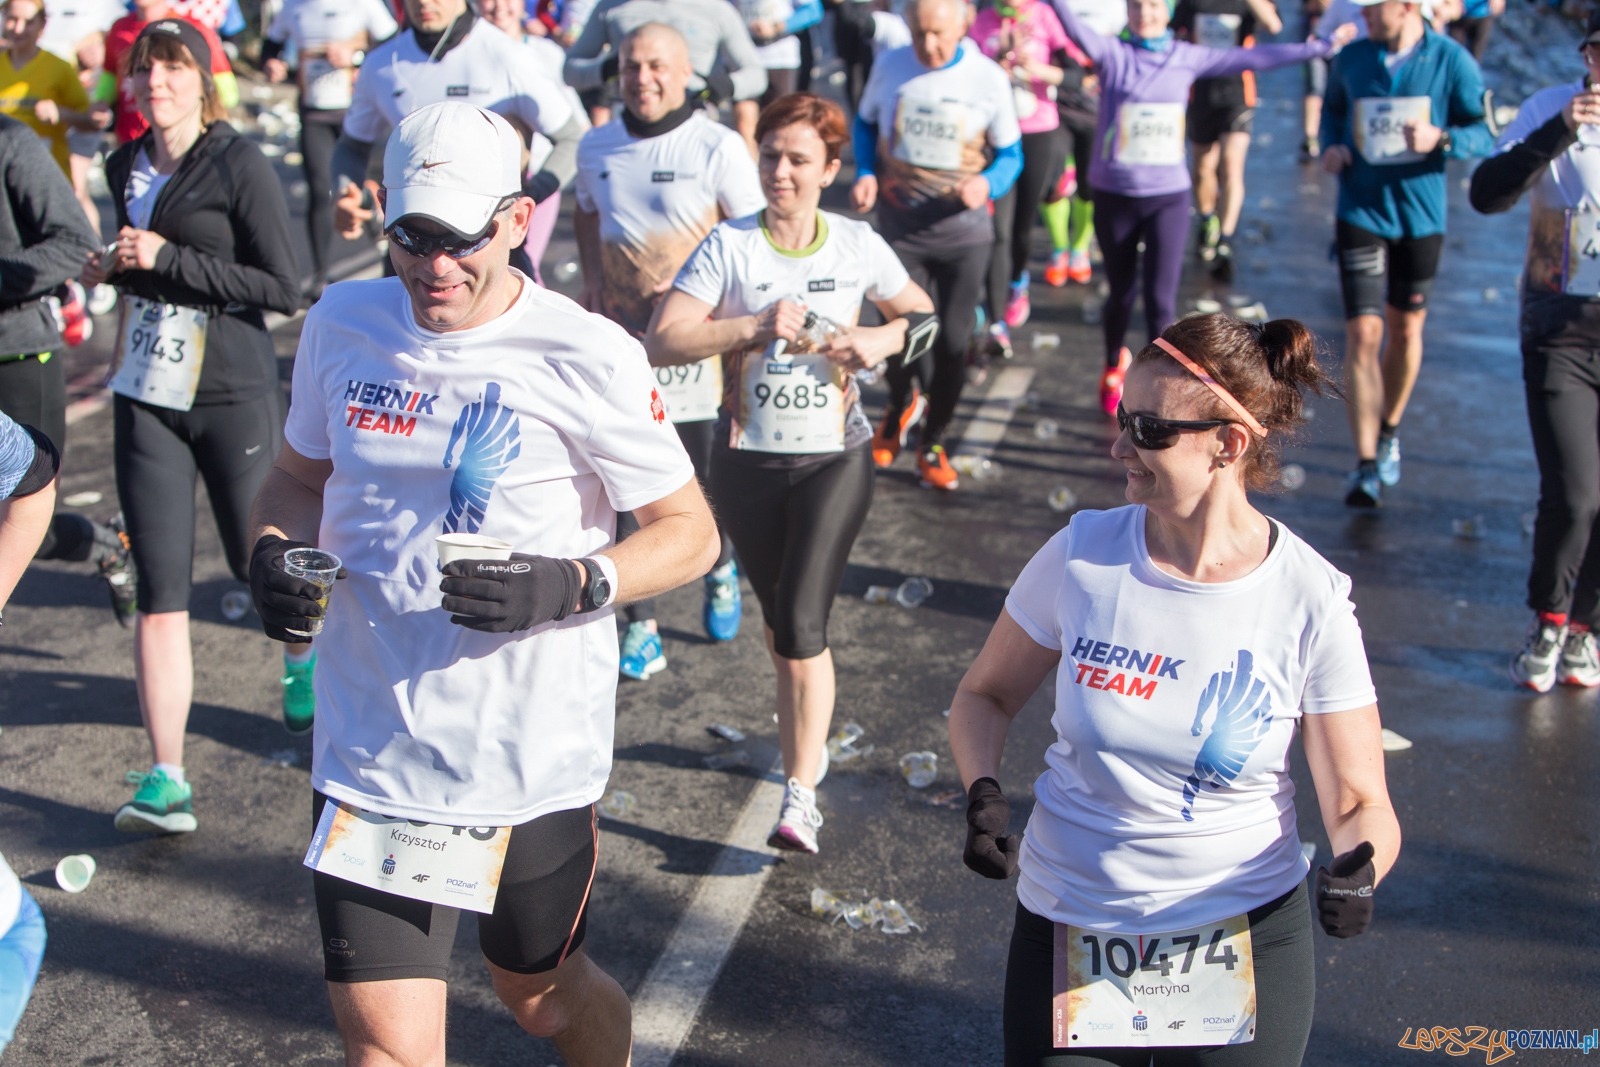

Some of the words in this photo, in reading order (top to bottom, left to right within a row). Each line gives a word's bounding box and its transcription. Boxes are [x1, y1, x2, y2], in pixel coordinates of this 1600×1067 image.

[905, 117, 957, 140] 10182
[131, 328, 186, 363] 9143
[343, 379, 440, 415] HERNIK
[754, 382, 828, 409] 9685
[346, 405, 417, 437] TEAM
[1070, 636, 1187, 680] HERNIK
[1075, 663, 1158, 701] TEAM
[390, 828, 448, 852] Krzysztof
[411, 873, 431, 883] 4F
[1082, 929, 1239, 979] 10474
[1134, 983, 1190, 998] Martyna
[1167, 1020, 1186, 1030] 4F
